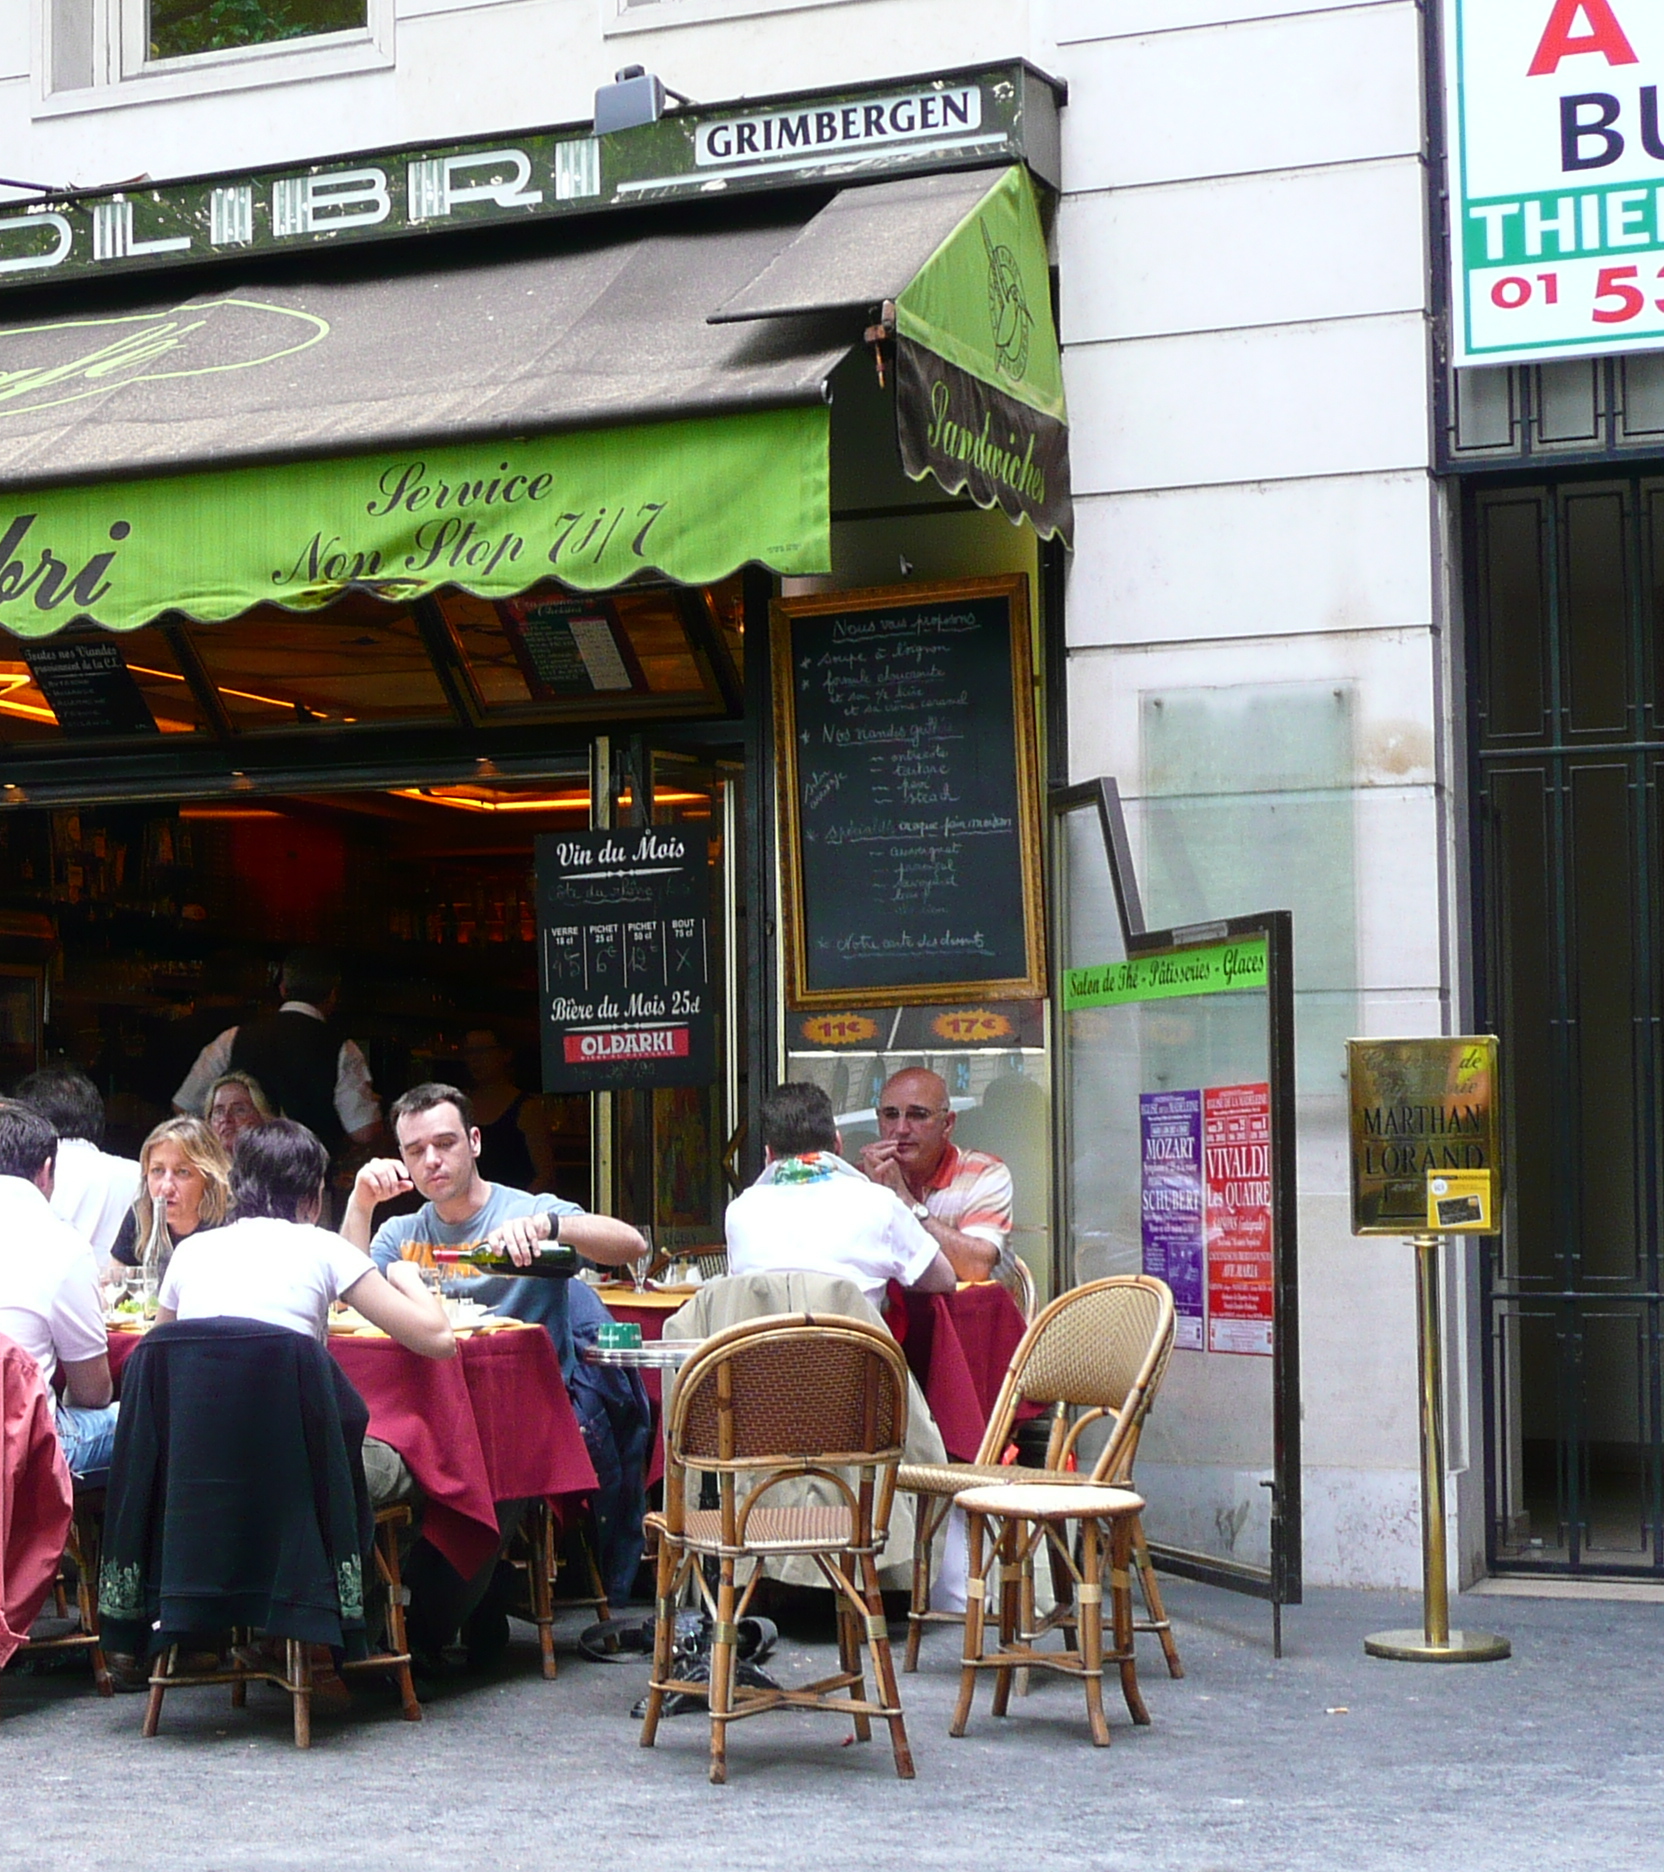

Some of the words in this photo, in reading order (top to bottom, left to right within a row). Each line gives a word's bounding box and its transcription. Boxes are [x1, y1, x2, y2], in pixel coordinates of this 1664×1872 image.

[706, 91, 970, 159] GRIMBERGEN
[1469, 186, 1664, 261] THIE
[1490, 272, 1559, 310] 01
[1591, 264, 1664, 324] 5
[927, 380, 1046, 505] Sandwiches
[366, 460, 555, 518] Service
[270, 530, 385, 588] Non
[404, 516, 526, 577] Stop
[556, 842, 594, 867] Vin
[598, 839, 627, 865] du
[632, 834, 686, 862] Mois
[551, 926, 579, 937] VERRE
[589, 923, 618, 934] PICHET
[628, 920, 657, 932] PICHET
[671, 918, 696, 930] BOUT
[1069, 970, 1100, 998] Salon
[1102, 967, 1115, 992] de
[1222, 948, 1265, 985] Glaces
[550, 997, 595, 1022] Bière
[597, 995, 620, 1020] du
[624, 992, 666, 1018] Mois
[947, 1018, 996, 1034] 17€
[580, 1030, 674, 1056] OLDARKI
[1364, 1103, 1483, 1136] MARTHAN
[1146, 1137, 1195, 1160] MOZART
[1207, 1145, 1270, 1179] VIVALDI
[1365, 1144, 1485, 1176] LORAND
[1142, 1189, 1200, 1211] SCHUBERT
[1225, 1180, 1271, 1215] QUATRE
